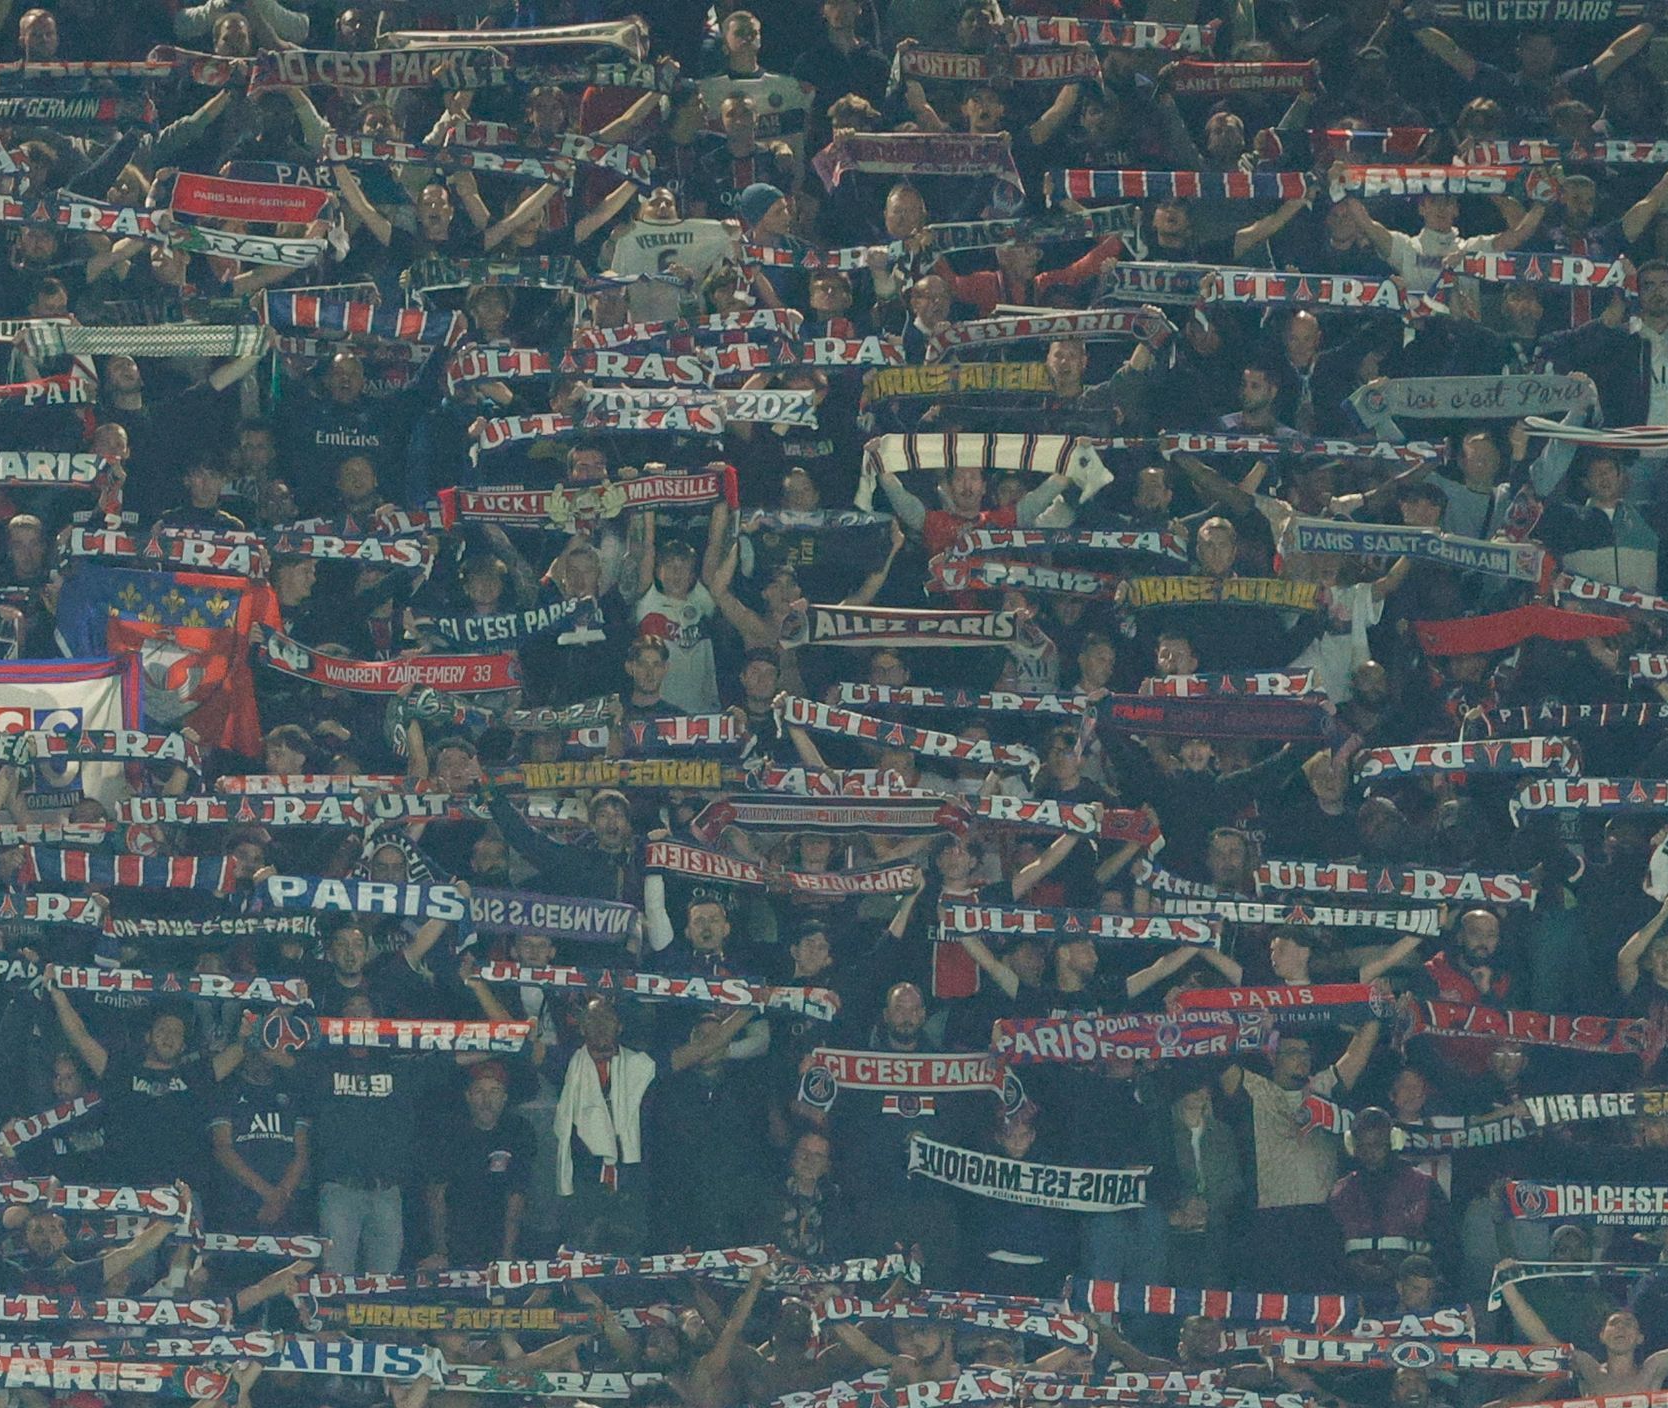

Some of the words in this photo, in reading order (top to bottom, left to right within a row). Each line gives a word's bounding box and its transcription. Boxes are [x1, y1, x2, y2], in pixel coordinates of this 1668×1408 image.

[1467, 1, 1490, 20] ICI
[1498, 1, 1548, 20] C'EST
[1553, 1, 1610, 20] PARIS
[278, 52, 308, 81] ICI
[636, 232, 693, 249] VERRATTI
[467, 493, 543, 514] FUCK!
[627, 476, 718, 502] MARSEILLE
[1300, 530, 1355, 552] PARIS
[1361, 534, 1510, 571] SAINT-GERMAIN
[465, 615, 520, 643] C'EST
[813, 609, 910, 637] ALLEZ
[919, 611, 1015, 638] PARIS
[326, 665, 384, 684] WARREN
[472, 663, 491, 681] 33
[270, 875, 467, 919] PARIS
[1309, 905, 1441, 936] AUTEUIL
[1230, 990, 1313, 1006] PARIS
[1095, 1017, 1137, 1036] POUR
[1142, 1012, 1233, 1030] TOUJOURS
[1429, 1006, 1611, 1047] PARIS
[995, 1021, 1096, 1063] PARIS
[1100, 1041, 1150, 1061] FOR
[1161, 1036, 1227, 1058] EVER
[854, 1059, 925, 1087] C'EST
[929, 1060, 997, 1088] PARIS
[1525, 1092, 1636, 1124] VIRAGE
[1556, 1185, 1591, 1214] ICI
[1592, 1186, 1663, 1214] C'EST
